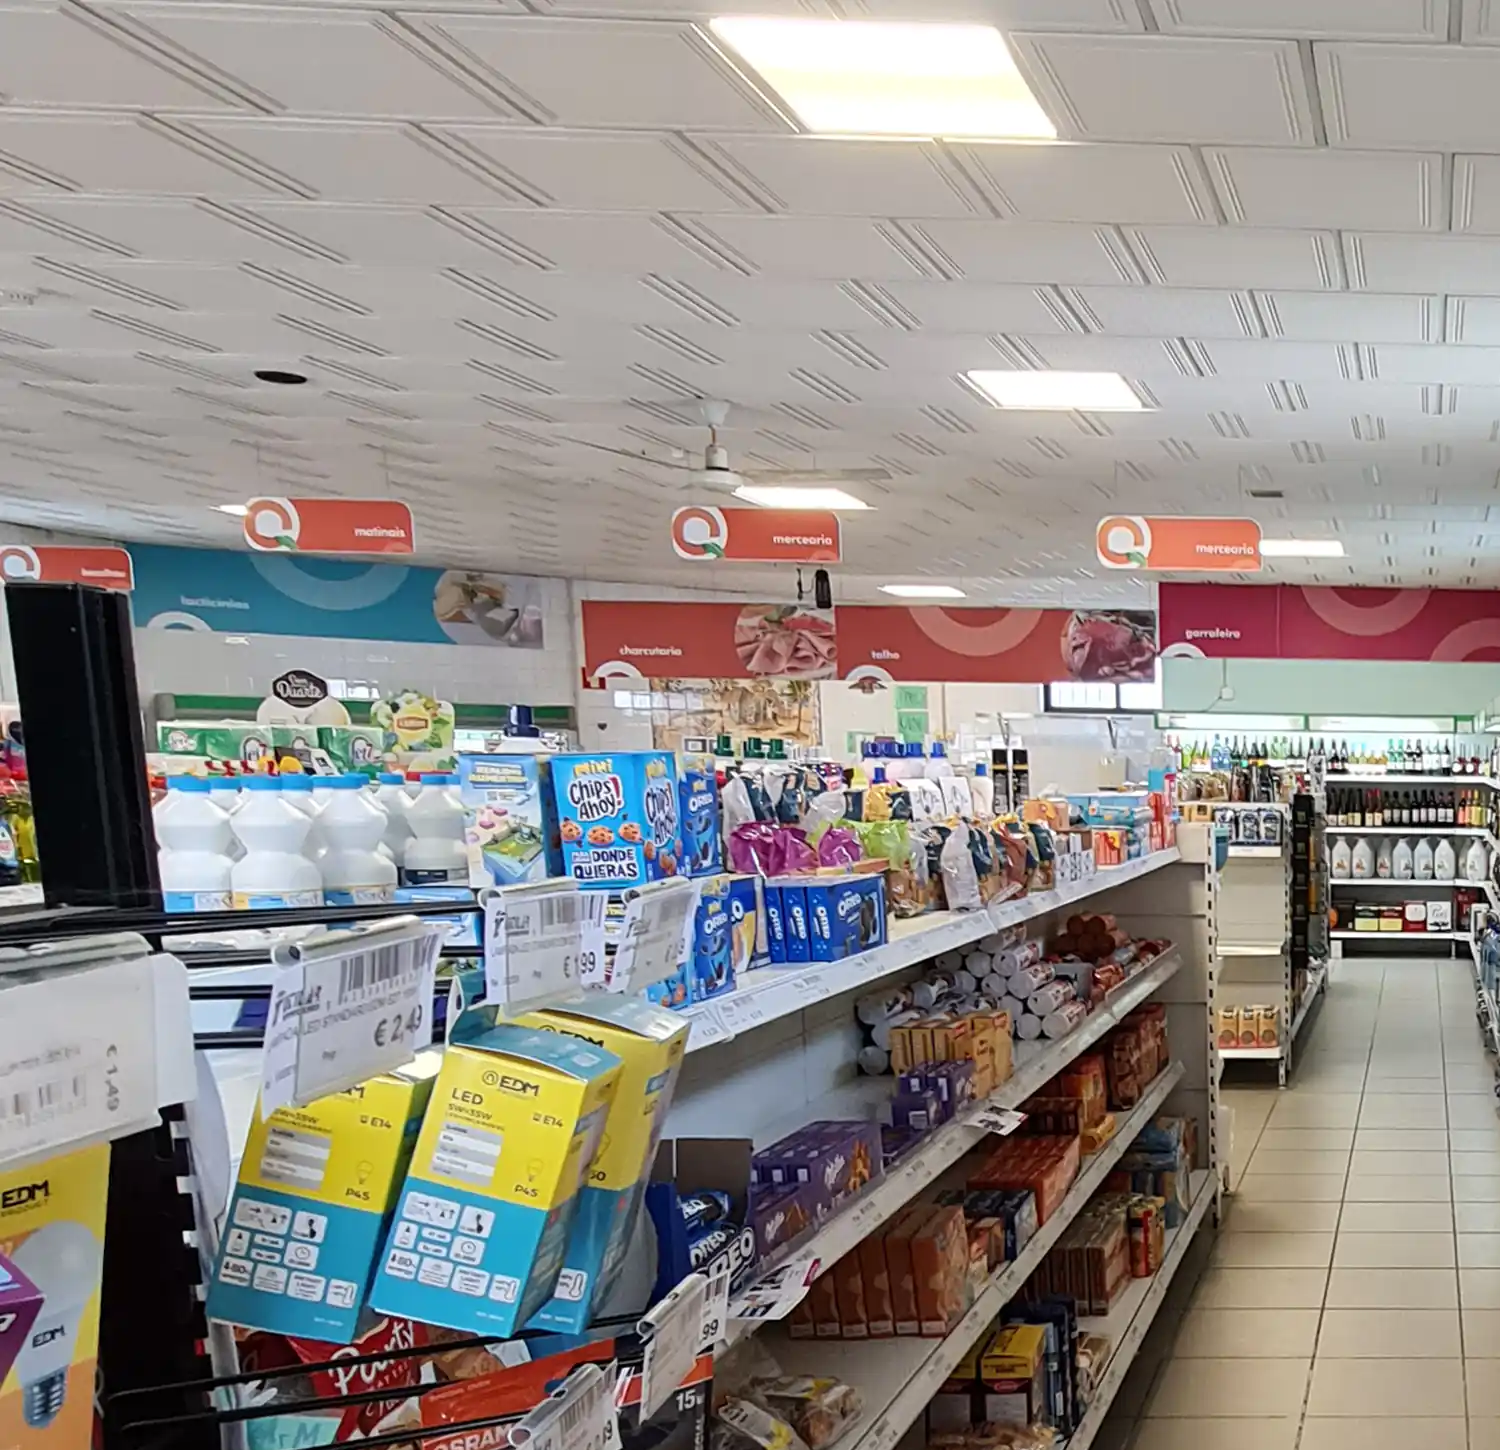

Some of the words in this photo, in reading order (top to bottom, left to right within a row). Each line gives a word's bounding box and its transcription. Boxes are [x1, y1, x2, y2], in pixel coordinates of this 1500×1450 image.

[354, 526, 407, 538] matinais
[773, 534, 833, 545] mercearia
[1196, 542, 1255, 556] mercearia
[1185, 627, 1241, 640] garrafeira
[871, 650, 900, 660] talho
[570, 779, 612, 803] Chips
[592, 848, 635, 863] DONDE
[573, 862, 639, 879] QUIERAS
[769, 907, 783, 941] OREO
[792, 906, 808, 941] OREO
[816, 905, 832, 940] OREO
[373, 1017, 388, 1047] €
[451, 1087, 485, 1107] LED
[498, 1074, 541, 1098] EDM
[1, 1179, 50, 1209] EDM
[32, 1323, 68, 1349] EDM
